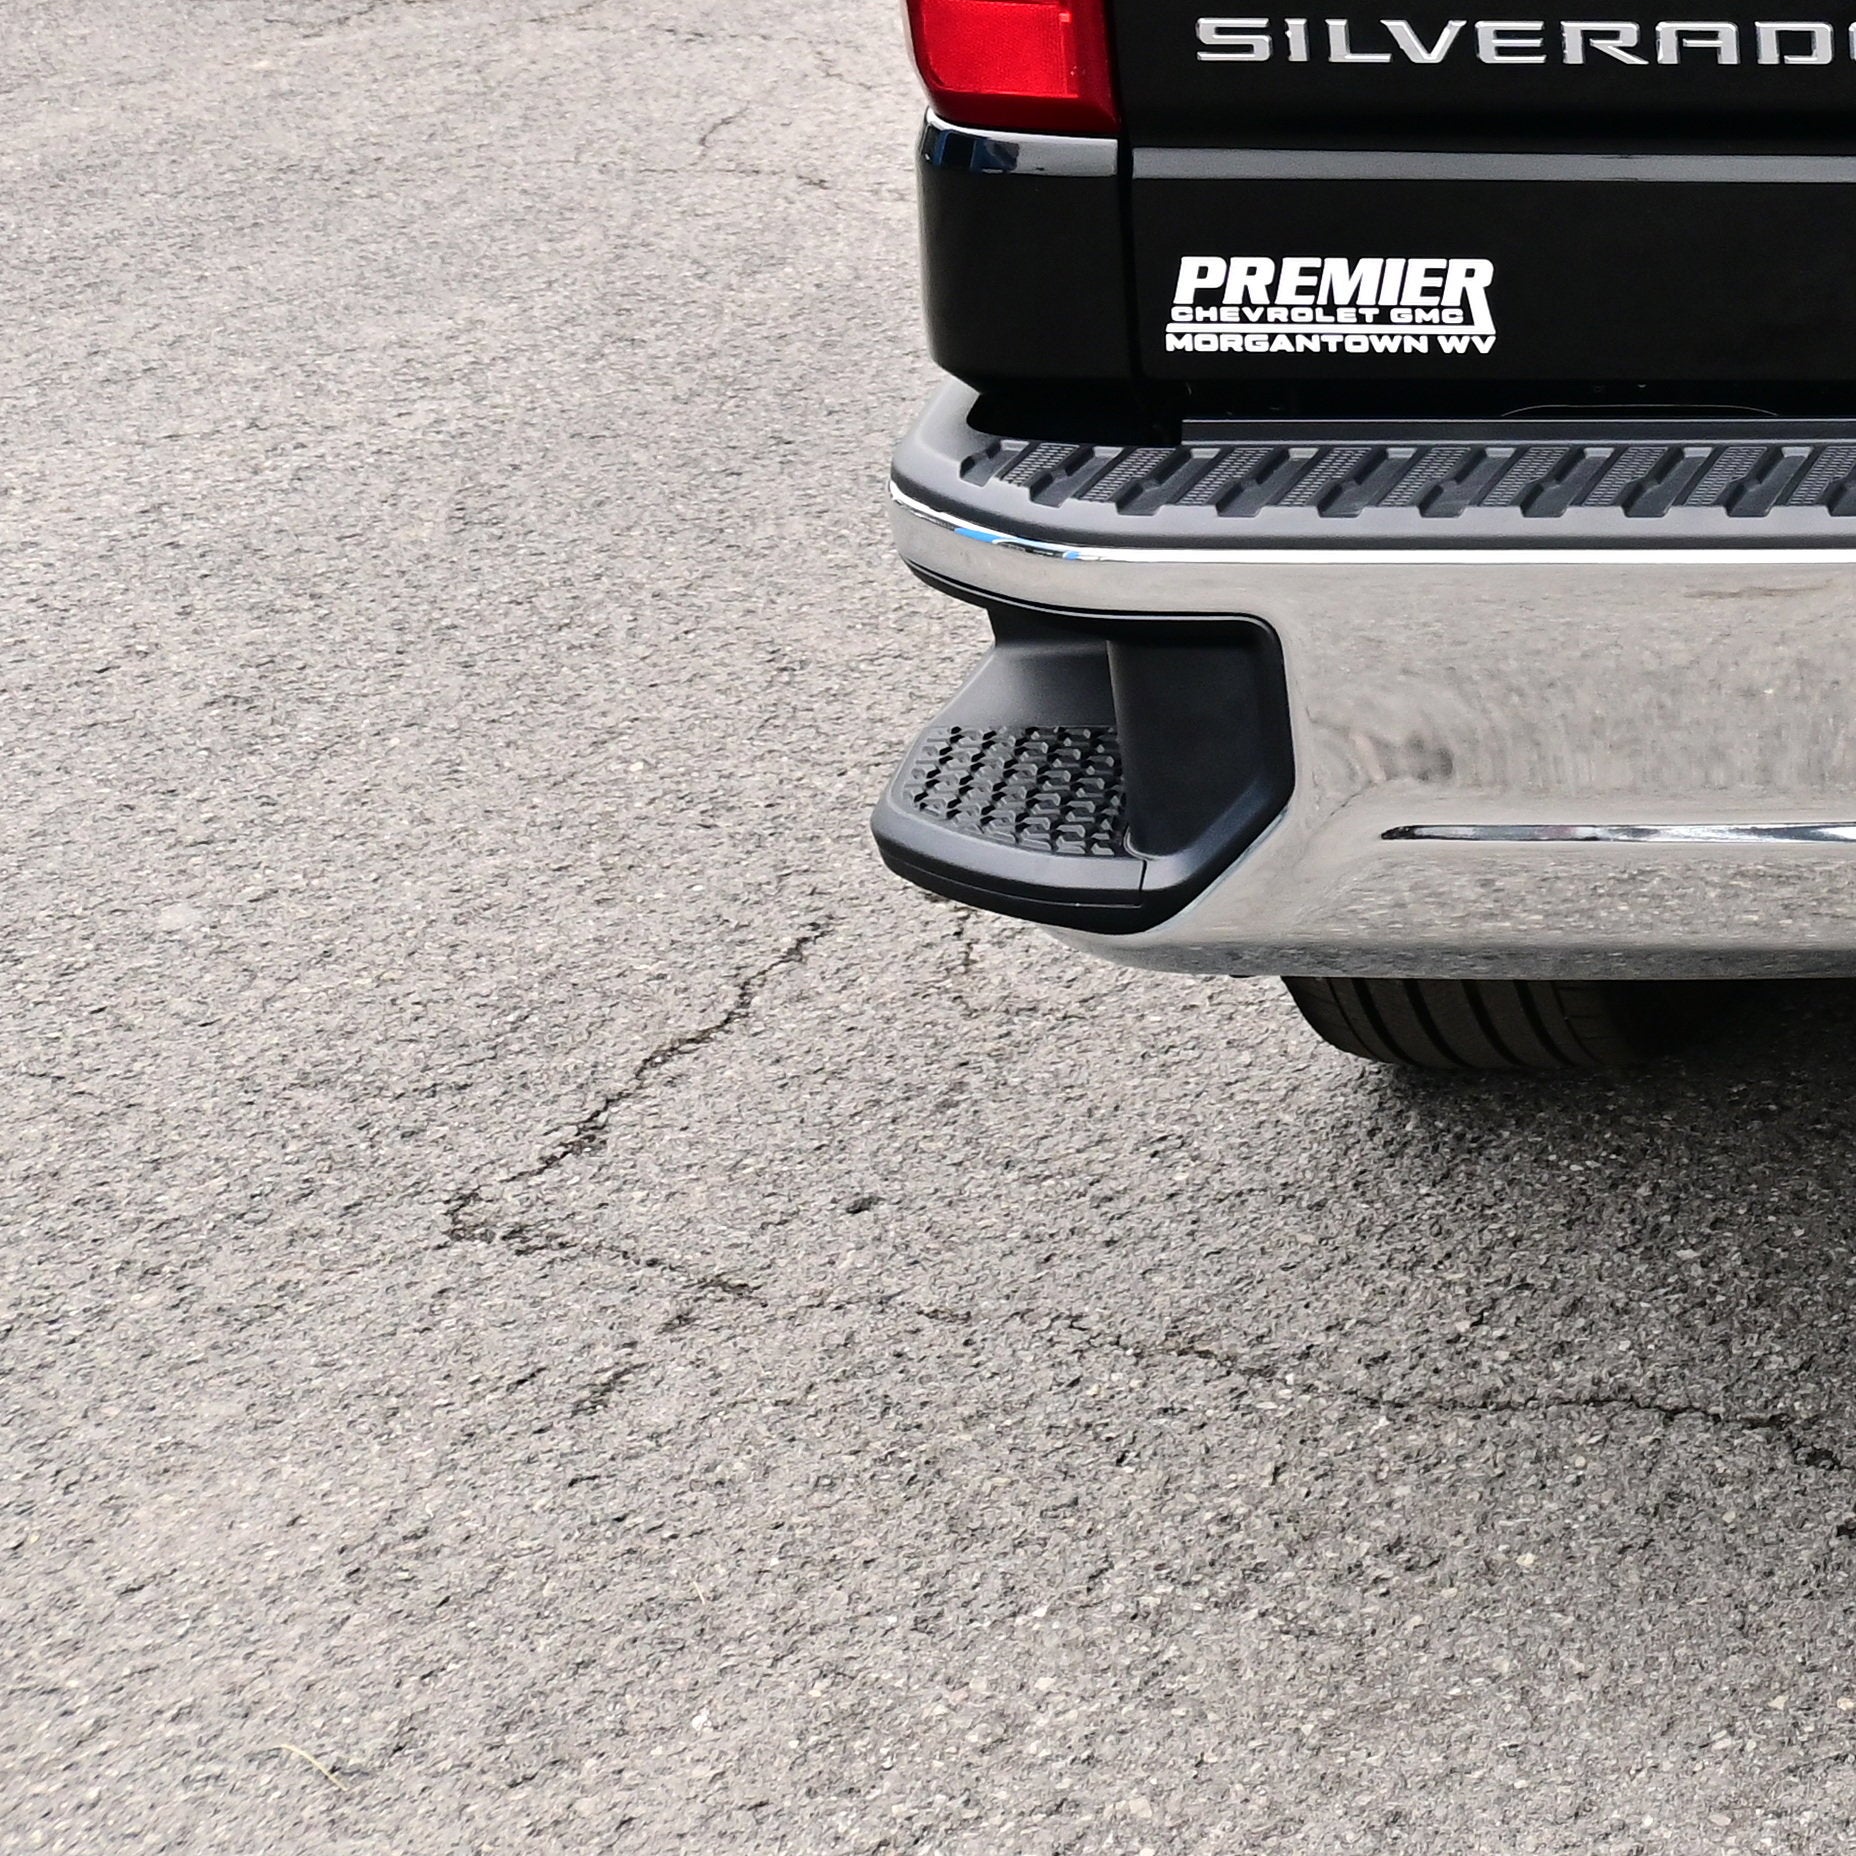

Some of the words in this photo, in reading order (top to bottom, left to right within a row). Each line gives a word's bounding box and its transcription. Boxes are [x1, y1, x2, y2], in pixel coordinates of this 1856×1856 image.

[1172, 256, 1495, 307] PREMIER
[1170, 306, 1380, 323] CHEVROLET
[1390, 307, 1464, 324] GMC
[1165, 334, 1429, 353] MORGANTOWN
[1437, 335, 1497, 354] WV
